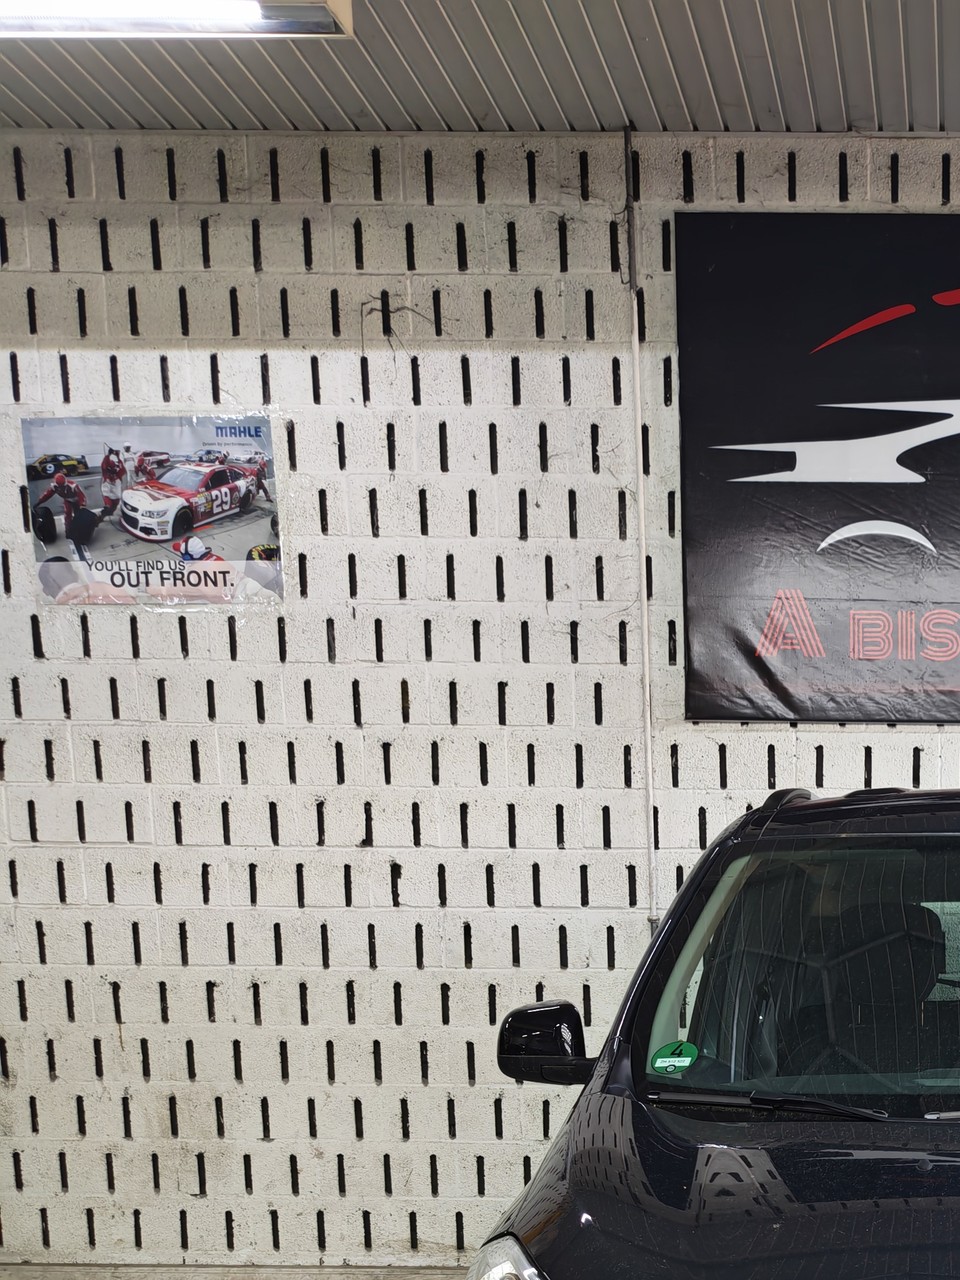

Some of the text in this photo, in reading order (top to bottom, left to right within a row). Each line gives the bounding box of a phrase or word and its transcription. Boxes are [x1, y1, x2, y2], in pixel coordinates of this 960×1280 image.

[215, 425, 262, 438] MAHLE
[46, 463, 55, 474] 9
[211, 487, 231, 514] 29
[86, 560, 186, 572] YOU'LL FIND US
[110, 570, 235, 588] OUT FRONT.
[755, 588, 826, 657] A
[670, 1042, 684, 1057] 4
